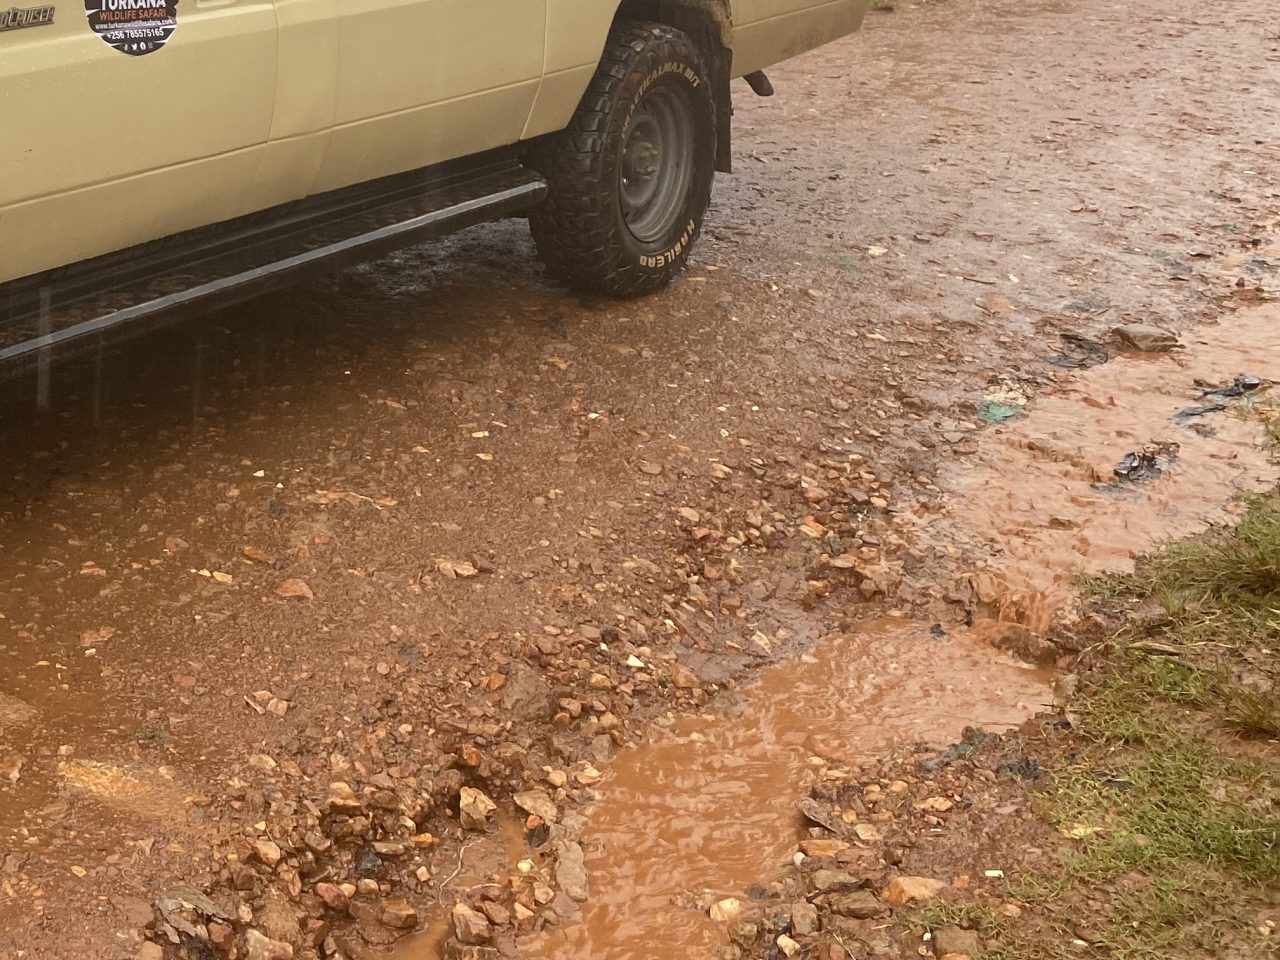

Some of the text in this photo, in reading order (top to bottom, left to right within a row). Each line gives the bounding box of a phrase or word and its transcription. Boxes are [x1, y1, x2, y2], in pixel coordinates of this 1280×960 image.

[100, 9, 167, 21] WILDLIFE SAFARI
[106, 31, 125, 40] +256
[639, 218, 695, 268] HABILEAD
